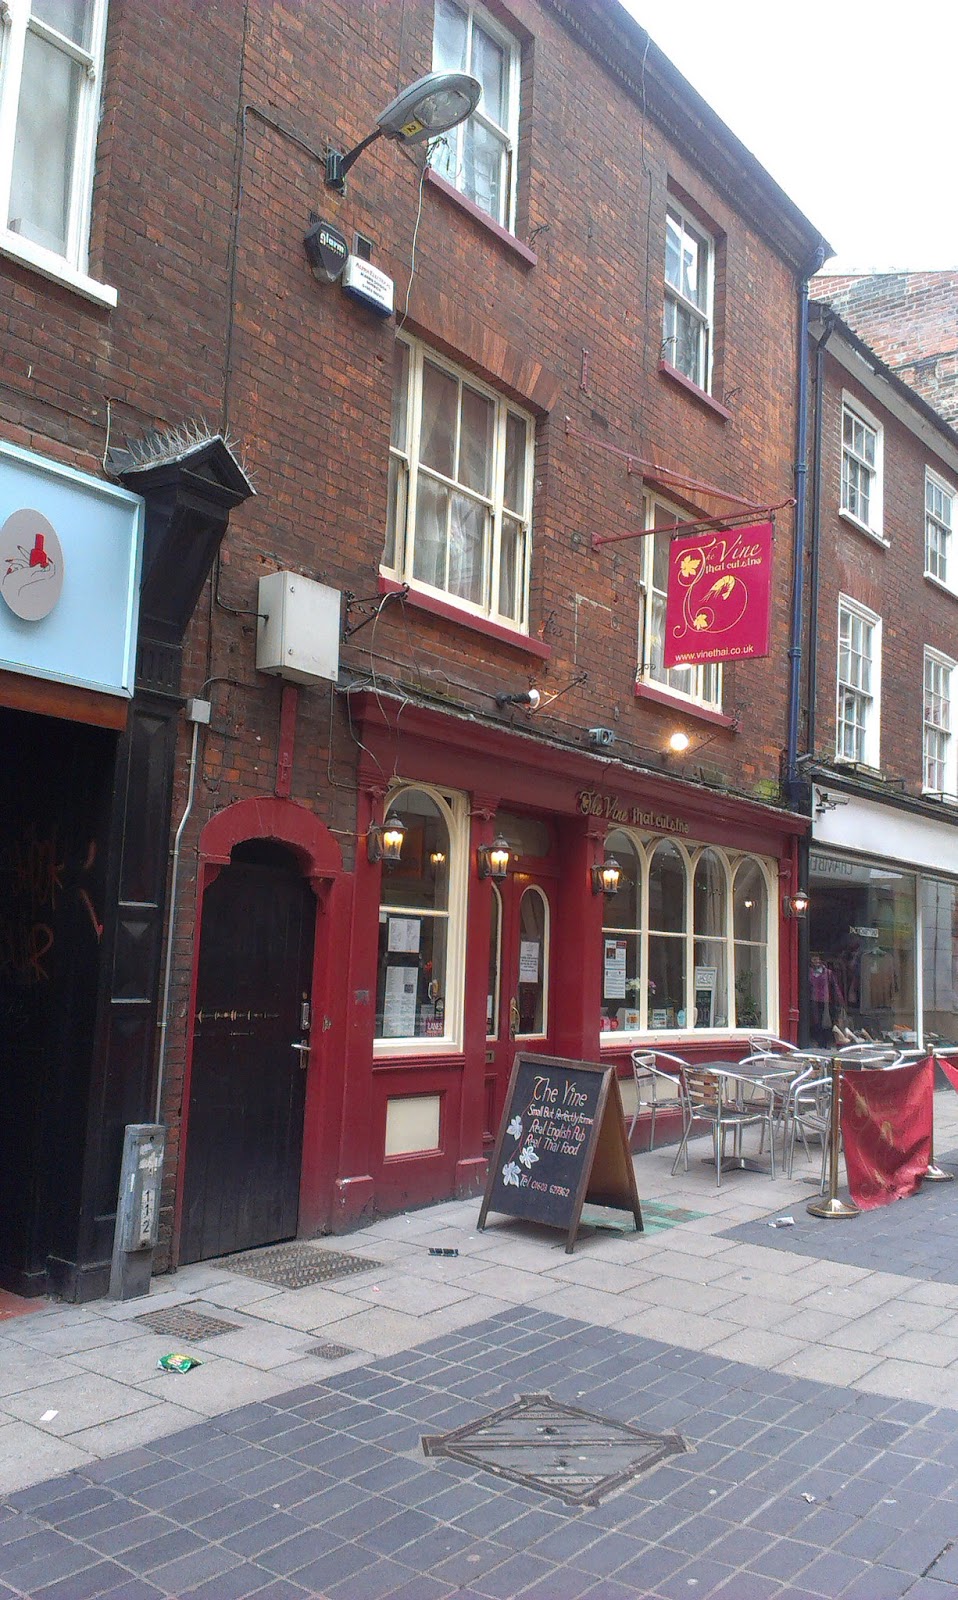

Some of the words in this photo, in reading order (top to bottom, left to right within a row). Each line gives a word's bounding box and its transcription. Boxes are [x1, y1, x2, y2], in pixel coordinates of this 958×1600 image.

[406, 124, 417, 133] 2
[716, 534, 762, 562] Vine
[705, 562, 725, 574] thai
[726, 557, 762, 569] cuisine
[674, 644, 754, 662] www.vinethai.co.uk
[579, 790, 603, 816] The
[603, 796, 629, 822] Vine
[632, 807, 655, 826] thai
[655, 814, 690, 834] cuisine
[533, 1076, 559, 1103] The
[562, 1080, 588, 1107] Vine
[528, 1104, 544, 1117] Small
[529, 1119, 547, 1135] Real
[546, 1121, 572, 1141] English
[572, 1126, 585, 1141] Pub
[525, 1134, 541, 1148] Real
[544, 1138, 560, 1152] Thai
[560, 1141, 581, 1156] Food
[520, 1174, 532, 1187] Tel
